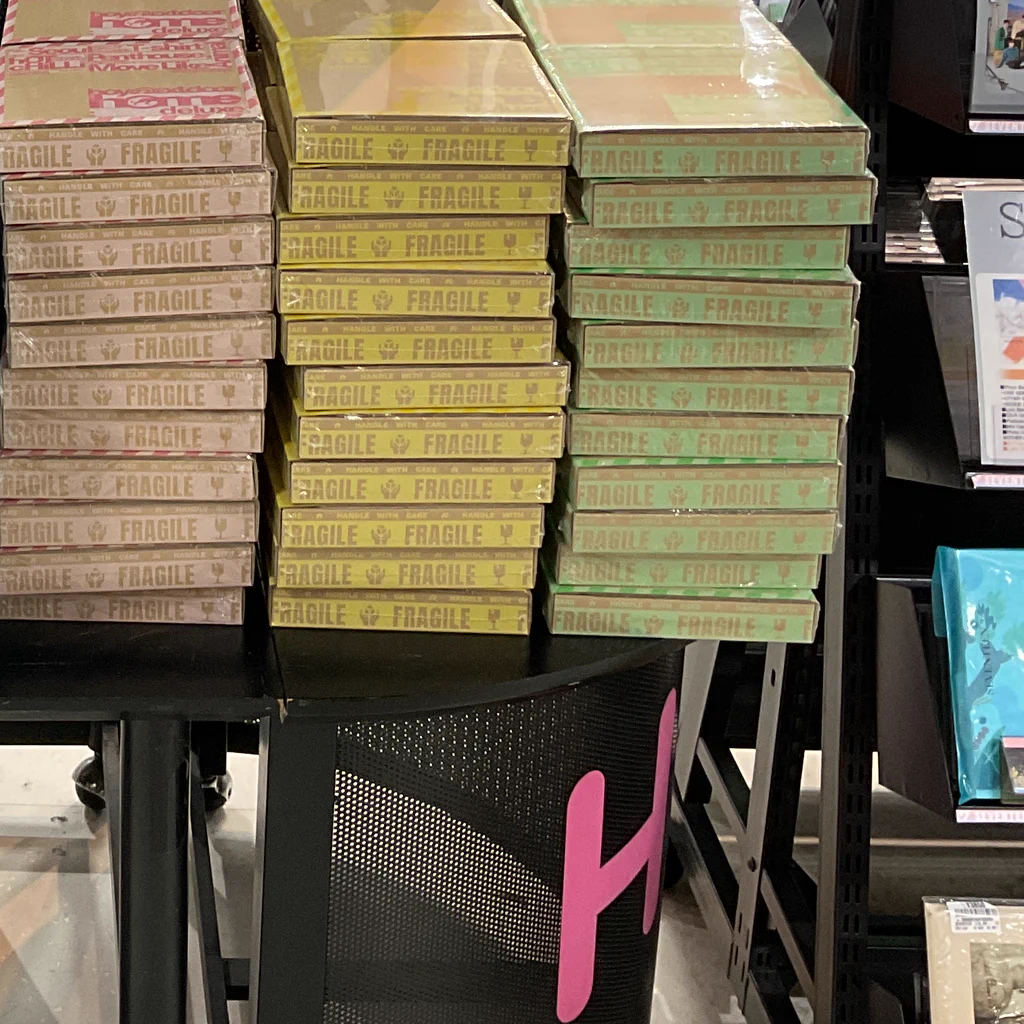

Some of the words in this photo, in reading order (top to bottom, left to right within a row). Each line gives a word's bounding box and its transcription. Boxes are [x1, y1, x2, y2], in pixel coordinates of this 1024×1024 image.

[121, 140, 201, 166] FRAGILE
[423, 138, 505, 162] FRAGILE
[714, 150, 801, 173] FRAGILE
[130, 192, 210, 217] FRAGILE
[418, 186, 500, 209] FRAGILE
[724, 199, 809, 222] FRAGILE
[132, 238, 212, 265] FRAGILE
[405, 233, 485, 257] FRAGILE
[700, 243, 783, 266] FRAGILE
[133, 286, 212, 312] FRAGILE
[407, 289, 489, 313] FRAGILE
[704, 297, 789, 323] FRAGILE
[412, 337, 492, 360] FRAGILE
[126, 384, 205, 407] FRAGILE
[428, 383, 507, 405] FRAGILE
[705, 387, 787, 410] FRAGILE
[424, 433, 502, 455] FRAGILE
[115, 474, 193, 497] FRAGILE
[414, 479, 492, 500] FRAGILE
[701, 484, 780, 506] FRAGILE
[120, 518, 197, 542] FRAGILE
[108, 599, 184, 621] FRAGILE
[392, 606, 471, 630] FRAGILE
[677, 615, 755, 638] FRAGILE
[556, 687, 676, 1023] H
